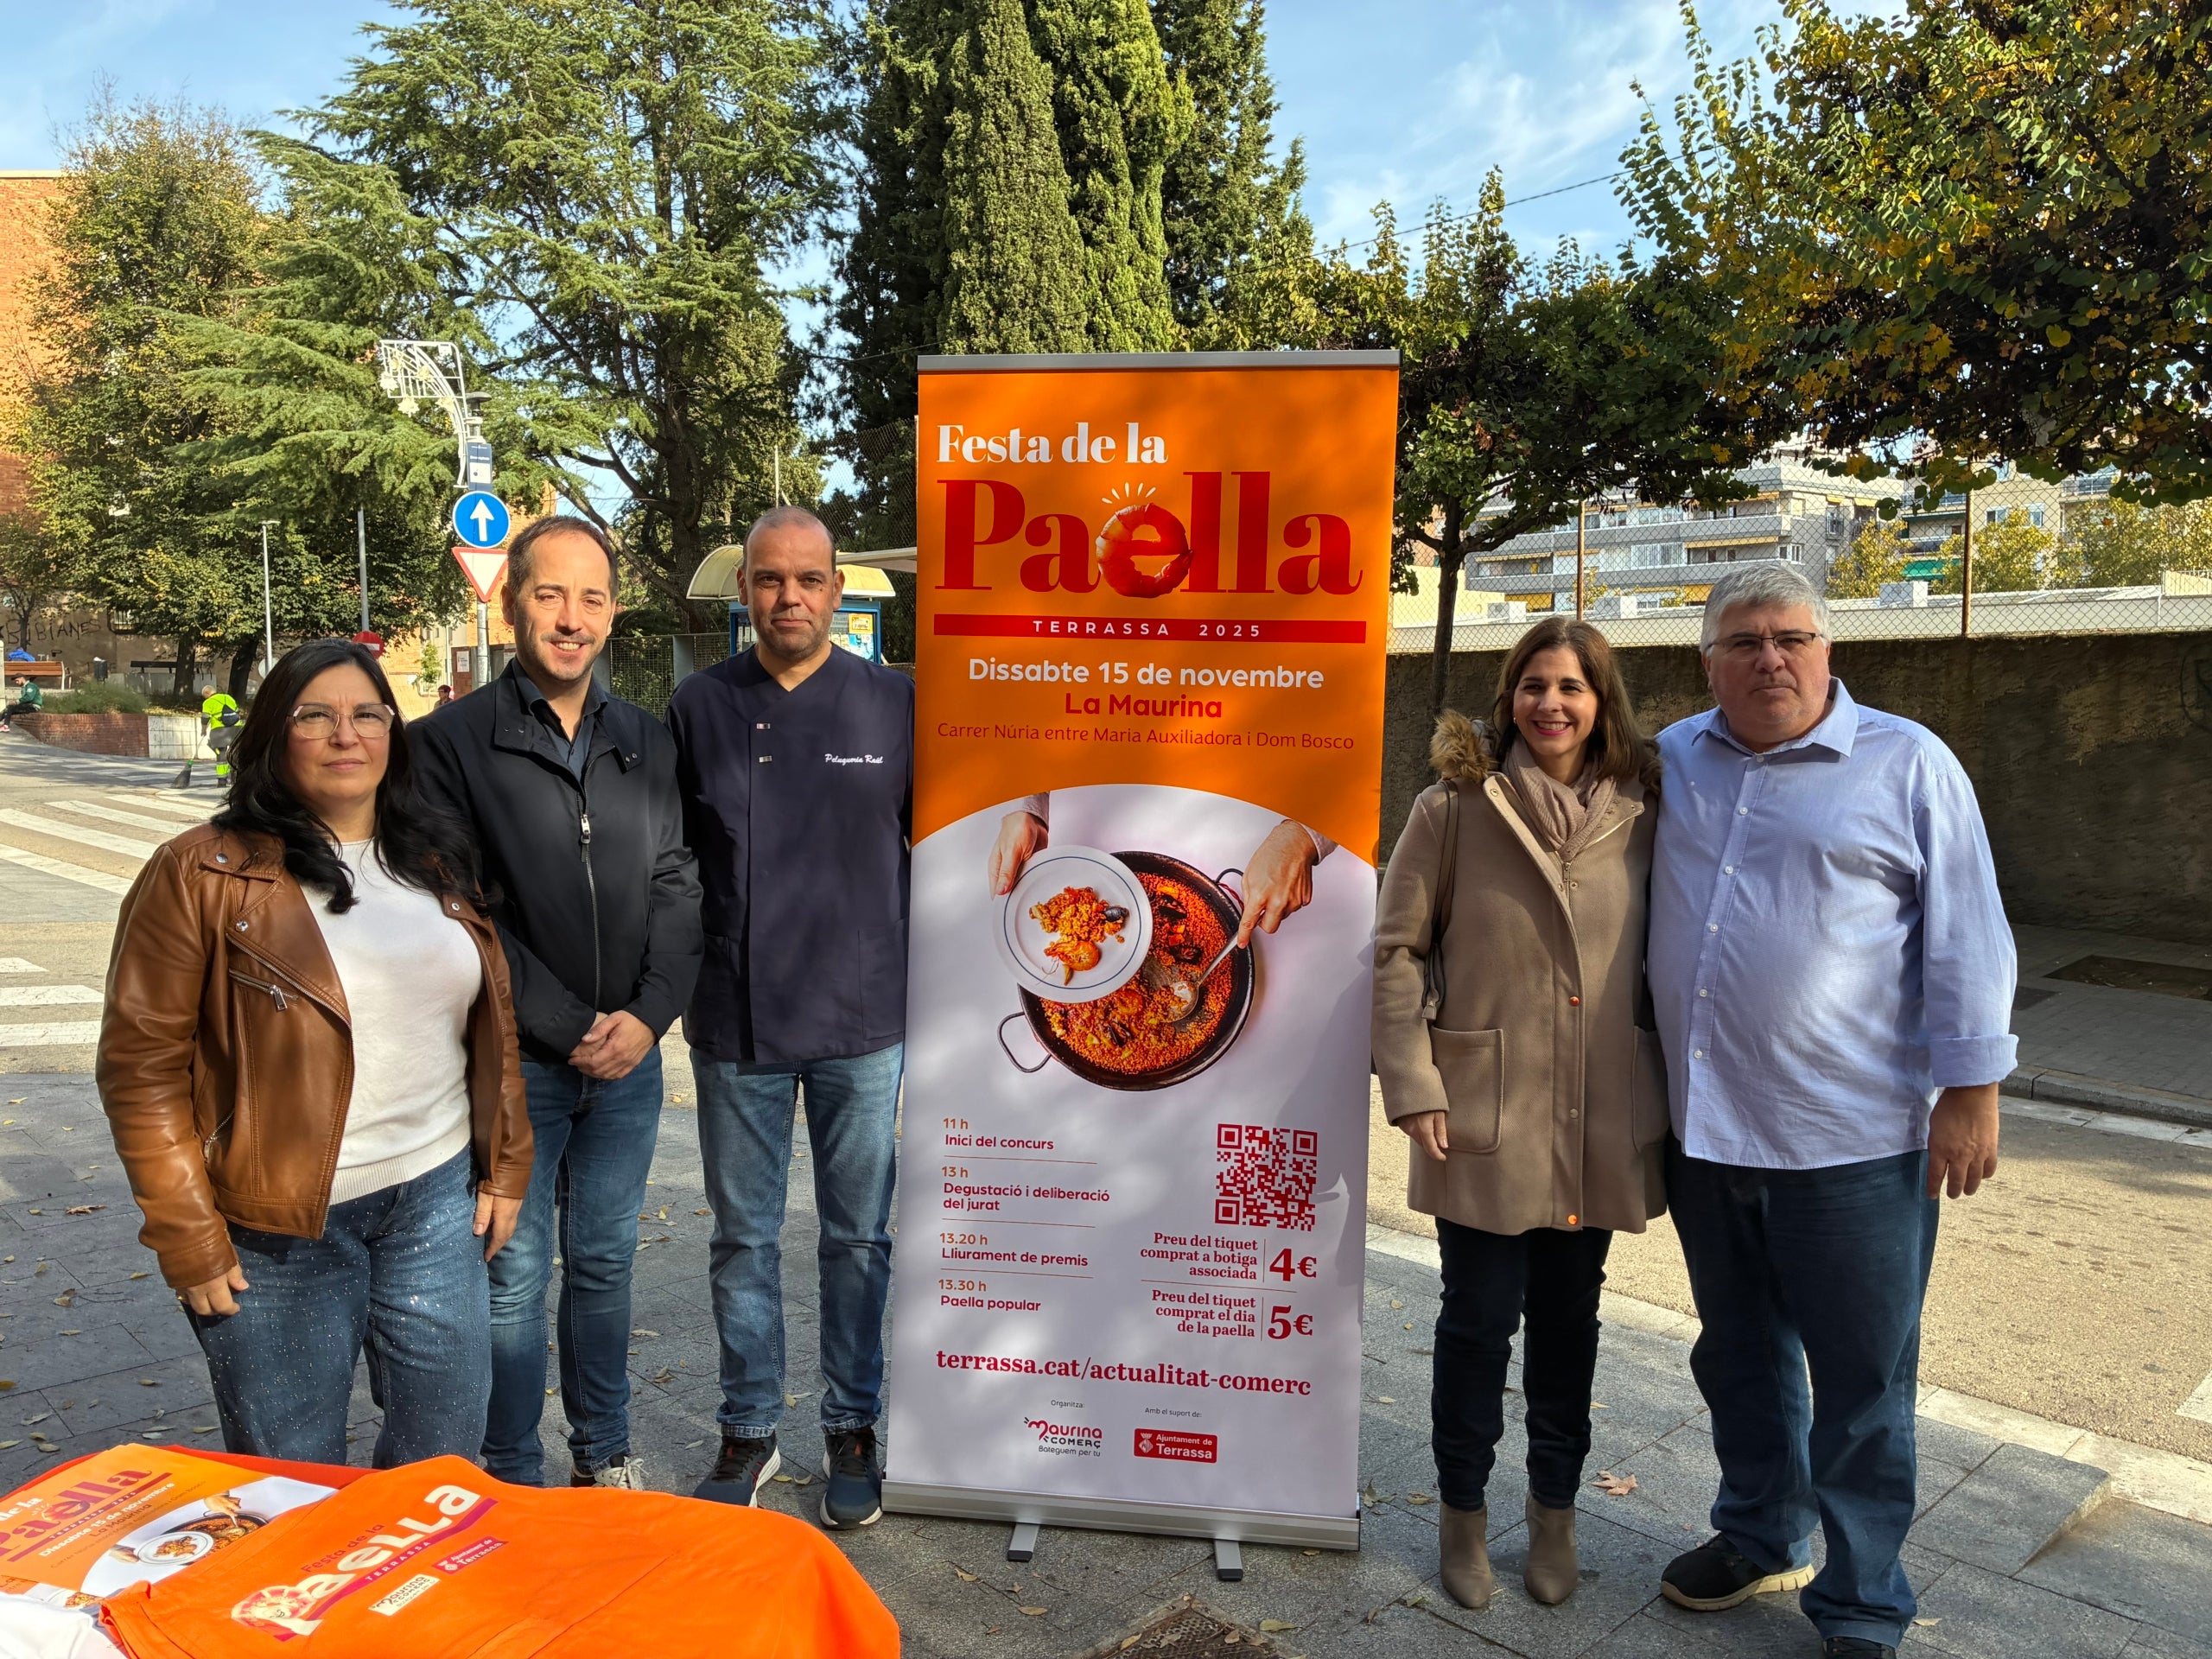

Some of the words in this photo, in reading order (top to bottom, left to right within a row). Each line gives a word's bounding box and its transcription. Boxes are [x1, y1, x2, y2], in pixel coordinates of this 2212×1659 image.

[936, 424, 1053, 464] Festa
[1062, 422, 1116, 464] de
[1124, 422, 1168, 465] la
[934, 471, 1363, 599] Paella
[1033, 620, 1170, 637] TERRASSA
[1199, 624, 1261, 638] 2025
[969, 658, 1089, 684] Dissabte
[1098, 662, 1129, 685] 15
[1136, 662, 1172, 687] de
[1179, 665, 1325, 690] novembre
[1065, 692, 1100, 715] La
[1109, 694, 1223, 719] Maurina
[938, 722, 989, 739] Carrer
[994, 723, 1039, 741] Núria
[1044, 727, 1089, 742] entre
[1093, 728, 1141, 744] Maria
[1147, 729, 1243, 747] Auxiliadora
[1246, 731, 1251, 747] i
[1256, 732, 1296, 748] Dom
[1301, 734, 1355, 750] Bosco
[943, 1118, 956, 1129] 11
[961, 1118, 969, 1129] h
[945, 1134, 972, 1147] Inici
[976, 1135, 996, 1147] del
[1000, 1138, 1054, 1150] concurs
[942, 1166, 957, 1178] 13
[961, 1166, 969, 1178] h
[944, 1182, 1022, 1198] Degustació
[1025, 1185, 1029, 1197] i
[1033, 1186, 1110, 1202] deliberació
[943, 1198, 964, 1210] del
[966, 1199, 1000, 1211] jurat
[939, 1233, 976, 1245] 13.20
[980, 1234, 988, 1245] h
[1154, 1232, 1187, 1246] Preu
[1190, 1234, 1211, 1248] del
[1214, 1236, 1258, 1252] tiquet
[942, 1247, 1017, 1262] Lliurament
[1020, 1251, 1038, 1263] de
[1040, 1254, 1089, 1267] premis
[1140, 1248, 1199, 1262] comprat
[1202, 1252, 1210, 1262] a
[1213, 1251, 1257, 1267] botiga
[1269, 1248, 1318, 1282] 4€
[1189, 1265, 1257, 1280] associada
[938, 1279, 975, 1291] 13.30
[978, 1280, 987, 1292] h
[940, 1294, 984, 1308] Paella
[987, 1297, 1041, 1312] popular
[1152, 1289, 1185, 1303] Preu
[1188, 1291, 1210, 1305] del
[1212, 1294, 1256, 1309] tiquet
[1155, 1306, 1215, 1321] comprat
[1217, 1308, 1230, 1321] el
[1233, 1310, 1255, 1323] dia
[1267, 1305, 1313, 1340] 5€
[1177, 1320, 1194, 1334] de
[1196, 1321, 1210, 1334] la
[1212, 1324, 1255, 1338] paella
[937, 1350, 1312, 1396] terrassa.cat/actualitat-comerc
[1169, 1408, 1191, 1418] suport
[1027, 1420, 1103, 1441] Maurina
[1156, 1434, 1200, 1445] Ajuntament
[1051, 1436, 1101, 1449] COMERÇ
[1156, 1443, 1212, 1459] Terrassa
[16, 1497, 44, 1509] la
[39, 1528, 92, 1556] Dissabte
[90, 1519, 106, 1528] 15
[106, 1511, 122, 1521] de
[123, 1483, 175, 1512] novembre
[89, 1527, 106, 1537] La
[301, 1548, 346, 1573] Festa
[347, 1535, 366, 1551] de
[366, 1523, 385, 1536] la
[365, 1541, 431, 1581] TERRASSA
